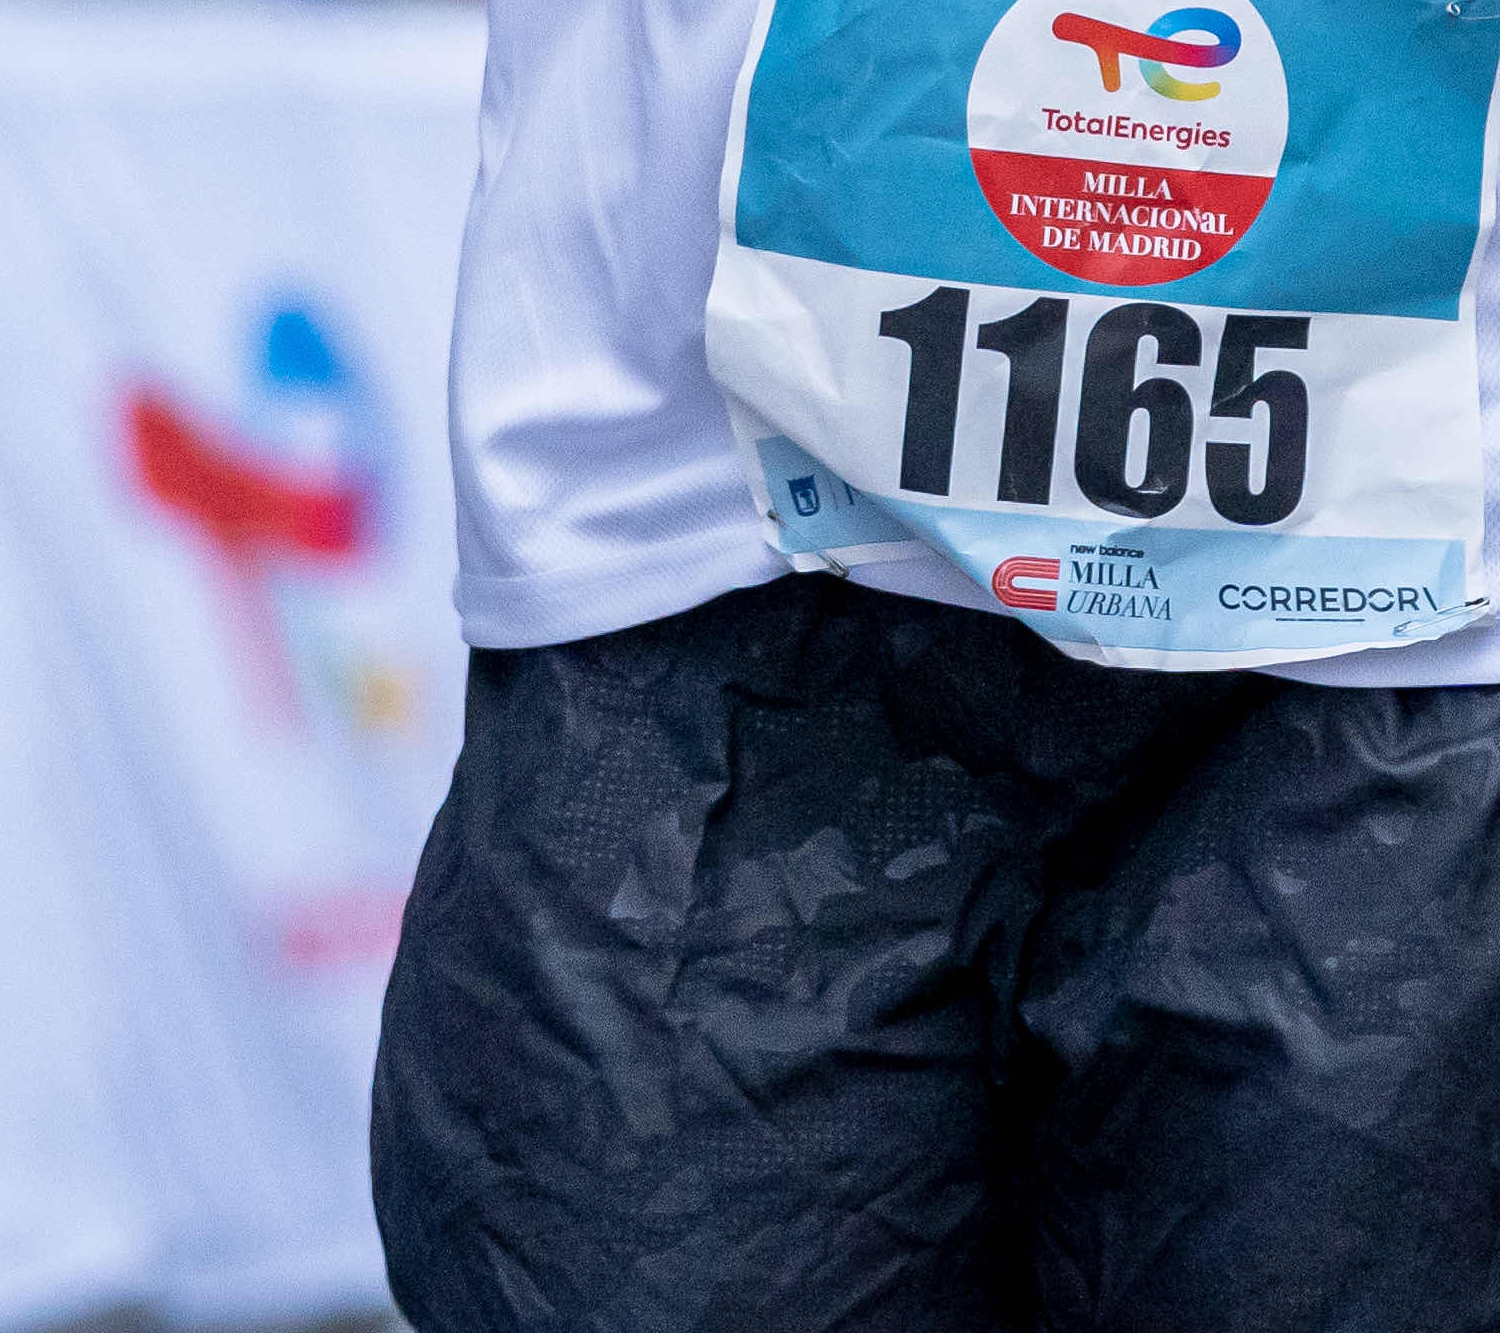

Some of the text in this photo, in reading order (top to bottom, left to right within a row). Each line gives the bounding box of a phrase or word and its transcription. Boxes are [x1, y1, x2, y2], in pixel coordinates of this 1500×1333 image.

[1042, 108, 1231, 150] TotalEnergies
[1082, 171, 1173, 201] MILLA
[1042, 226, 1202, 261] DE MADRID
[879, 286, 1311, 526] 1165
[1070, 544, 1145, 559] new balance
[1070, 560, 1161, 590] MILLA
[1066, 589, 1173, 621] URBANA
